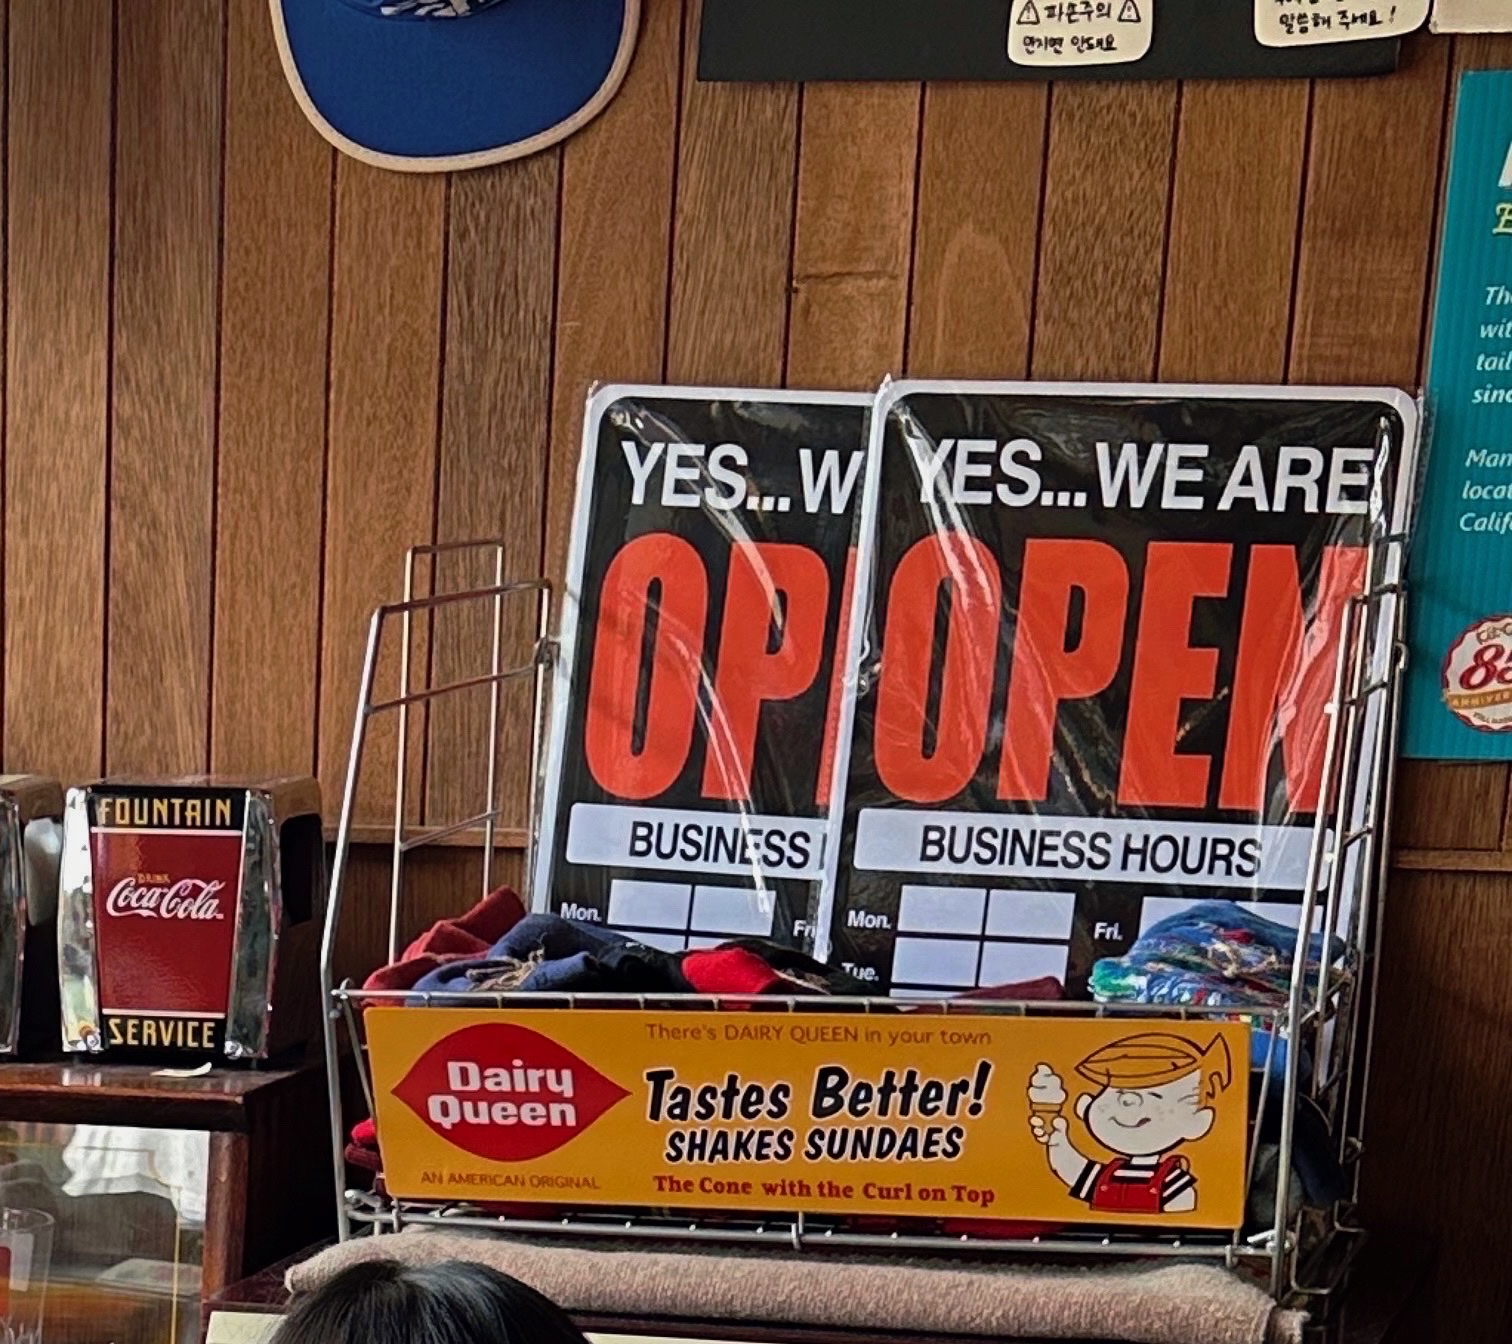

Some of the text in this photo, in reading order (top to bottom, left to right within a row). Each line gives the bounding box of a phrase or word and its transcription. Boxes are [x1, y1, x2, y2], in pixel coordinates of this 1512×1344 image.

[1219, 445, 1376, 515] ARE
[585, 532, 859, 806] OP
[874, 531, 1374, 812] OPEN
[98, 796, 232, 829] FOUNTAIN
[629, 821, 810, 869] BUSINESS
[920, 824, 1262, 877] BUSINESS HOURS
[106, 877, 226, 920] Coca-Cola
[560, 902, 602, 923] Mon.
[847, 910, 891, 931] Mon.
[1094, 920, 1123, 942] Fri.
[108, 1014, 216, 1050] SERVICE
[646, 1022, 992, 1050] There's DAIRY QUEEN in your town
[448, 1060, 574, 1098] Dairy
[645, 1062, 993, 1123] Tastes Better!
[427, 1096, 577, 1130] Queen
[664, 1126, 964, 1164] SHAKES SUNDAES
[420, 1171, 600, 1191] AN AMERICAN ORIGINAL
[653, 1175, 995, 1207] The Cone with the Curl on Top
